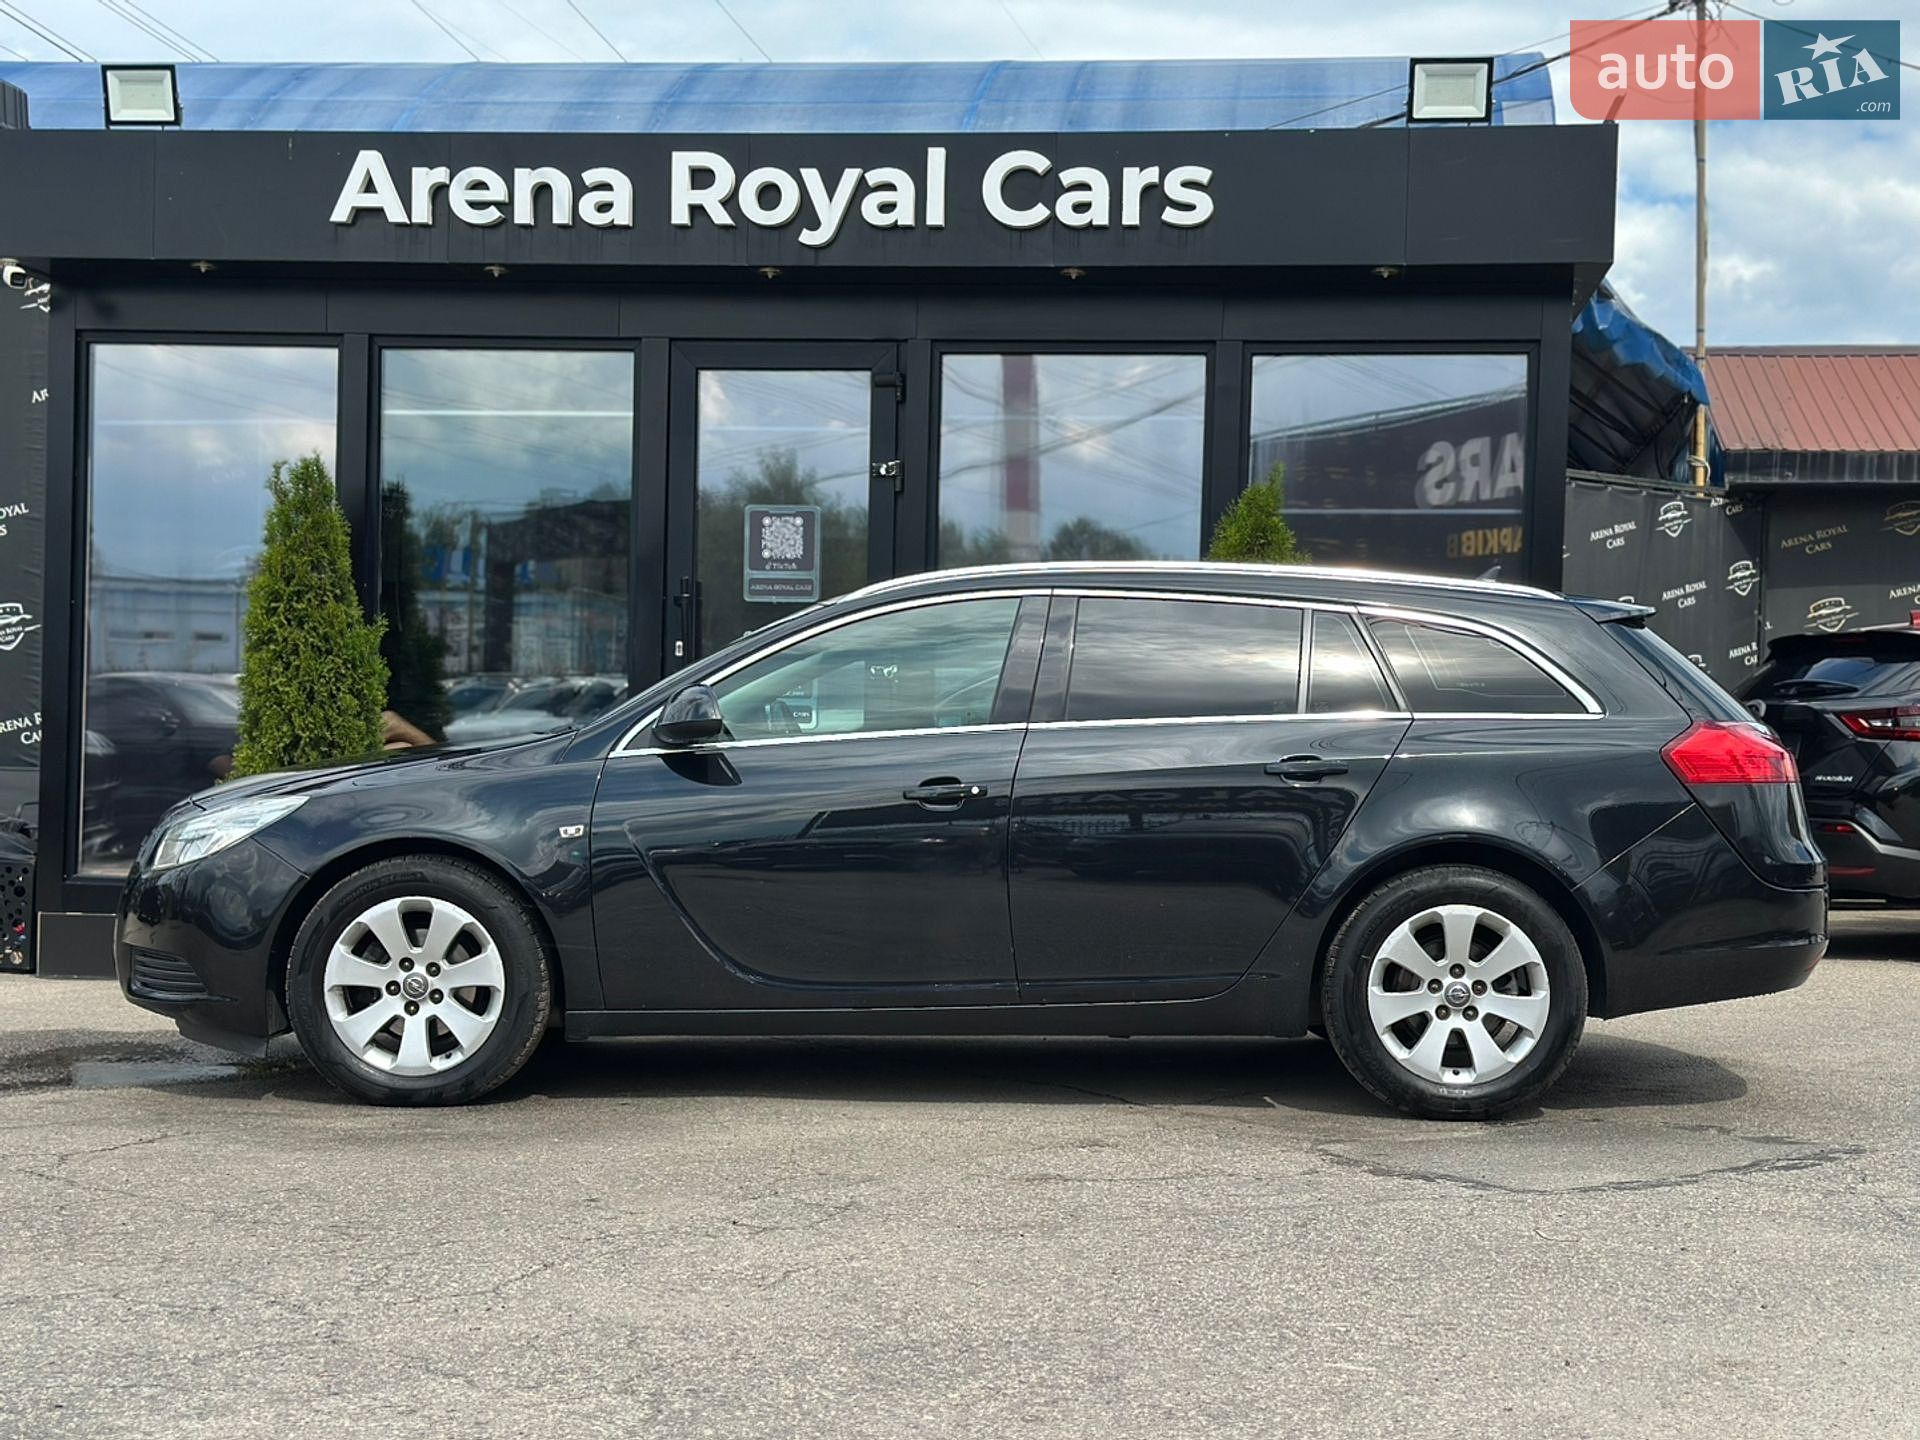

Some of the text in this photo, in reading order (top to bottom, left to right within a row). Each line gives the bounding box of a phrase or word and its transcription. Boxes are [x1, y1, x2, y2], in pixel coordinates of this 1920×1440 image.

[329, 147, 1214, 247] Arena Royal Cars
[1590, 521, 1637, 541] ARENA ROYAL
[1781, 524, 1848, 549] ARENA ROYAL
[1606, 537, 1625, 549] CARS
[1805, 542, 1833, 554] CARS
[1662, 581, 1707, 600] ARENA ROYAL
[1677, 596, 1696, 608] CARS
[1729, 645, 1751, 659] ARENA
